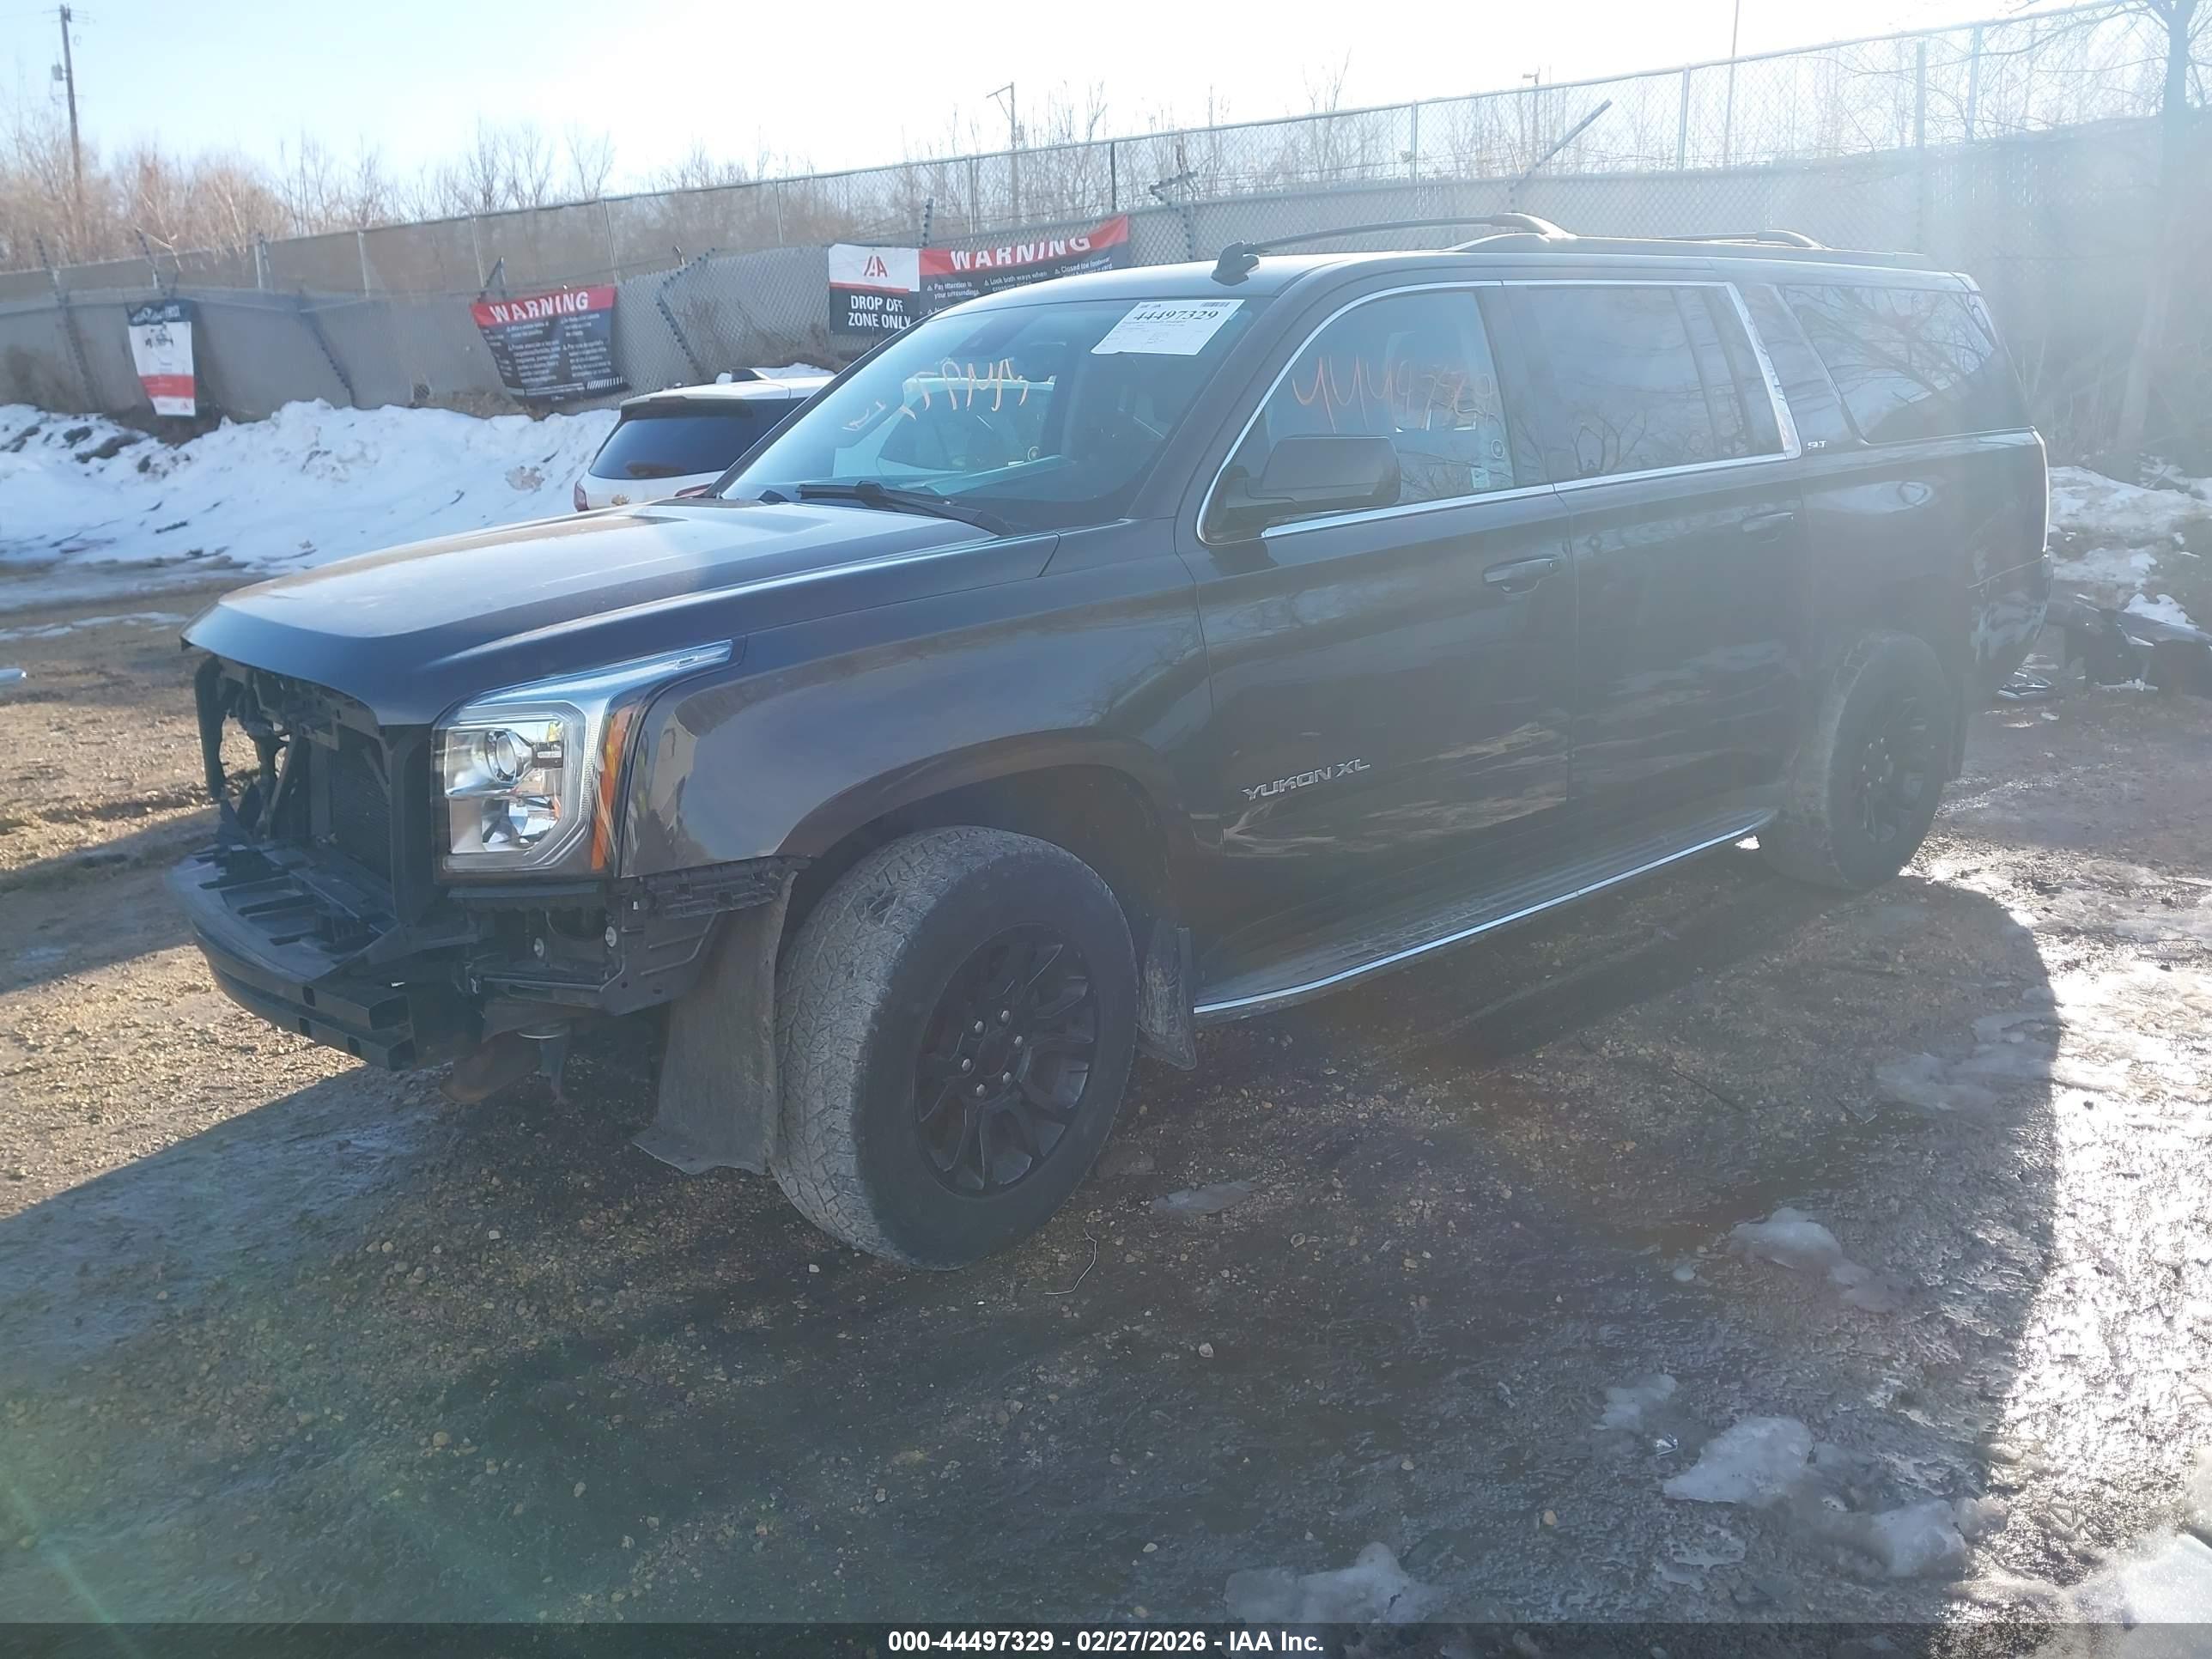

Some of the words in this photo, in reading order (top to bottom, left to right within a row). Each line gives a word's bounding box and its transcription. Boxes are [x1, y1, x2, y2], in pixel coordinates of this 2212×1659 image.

[950, 237, 1091, 270] WARNING
[489, 291, 588, 323] WARNING
[850, 295, 883, 311] DROP
[885, 299, 903, 313] OFF
[1133, 309, 1219, 321] 44497329
[848, 312, 880, 328] ZONE
[881, 314, 911, 329] ONLY
[1241, 766, 1332, 801] YUKON
[1335, 758, 1371, 778] XL
